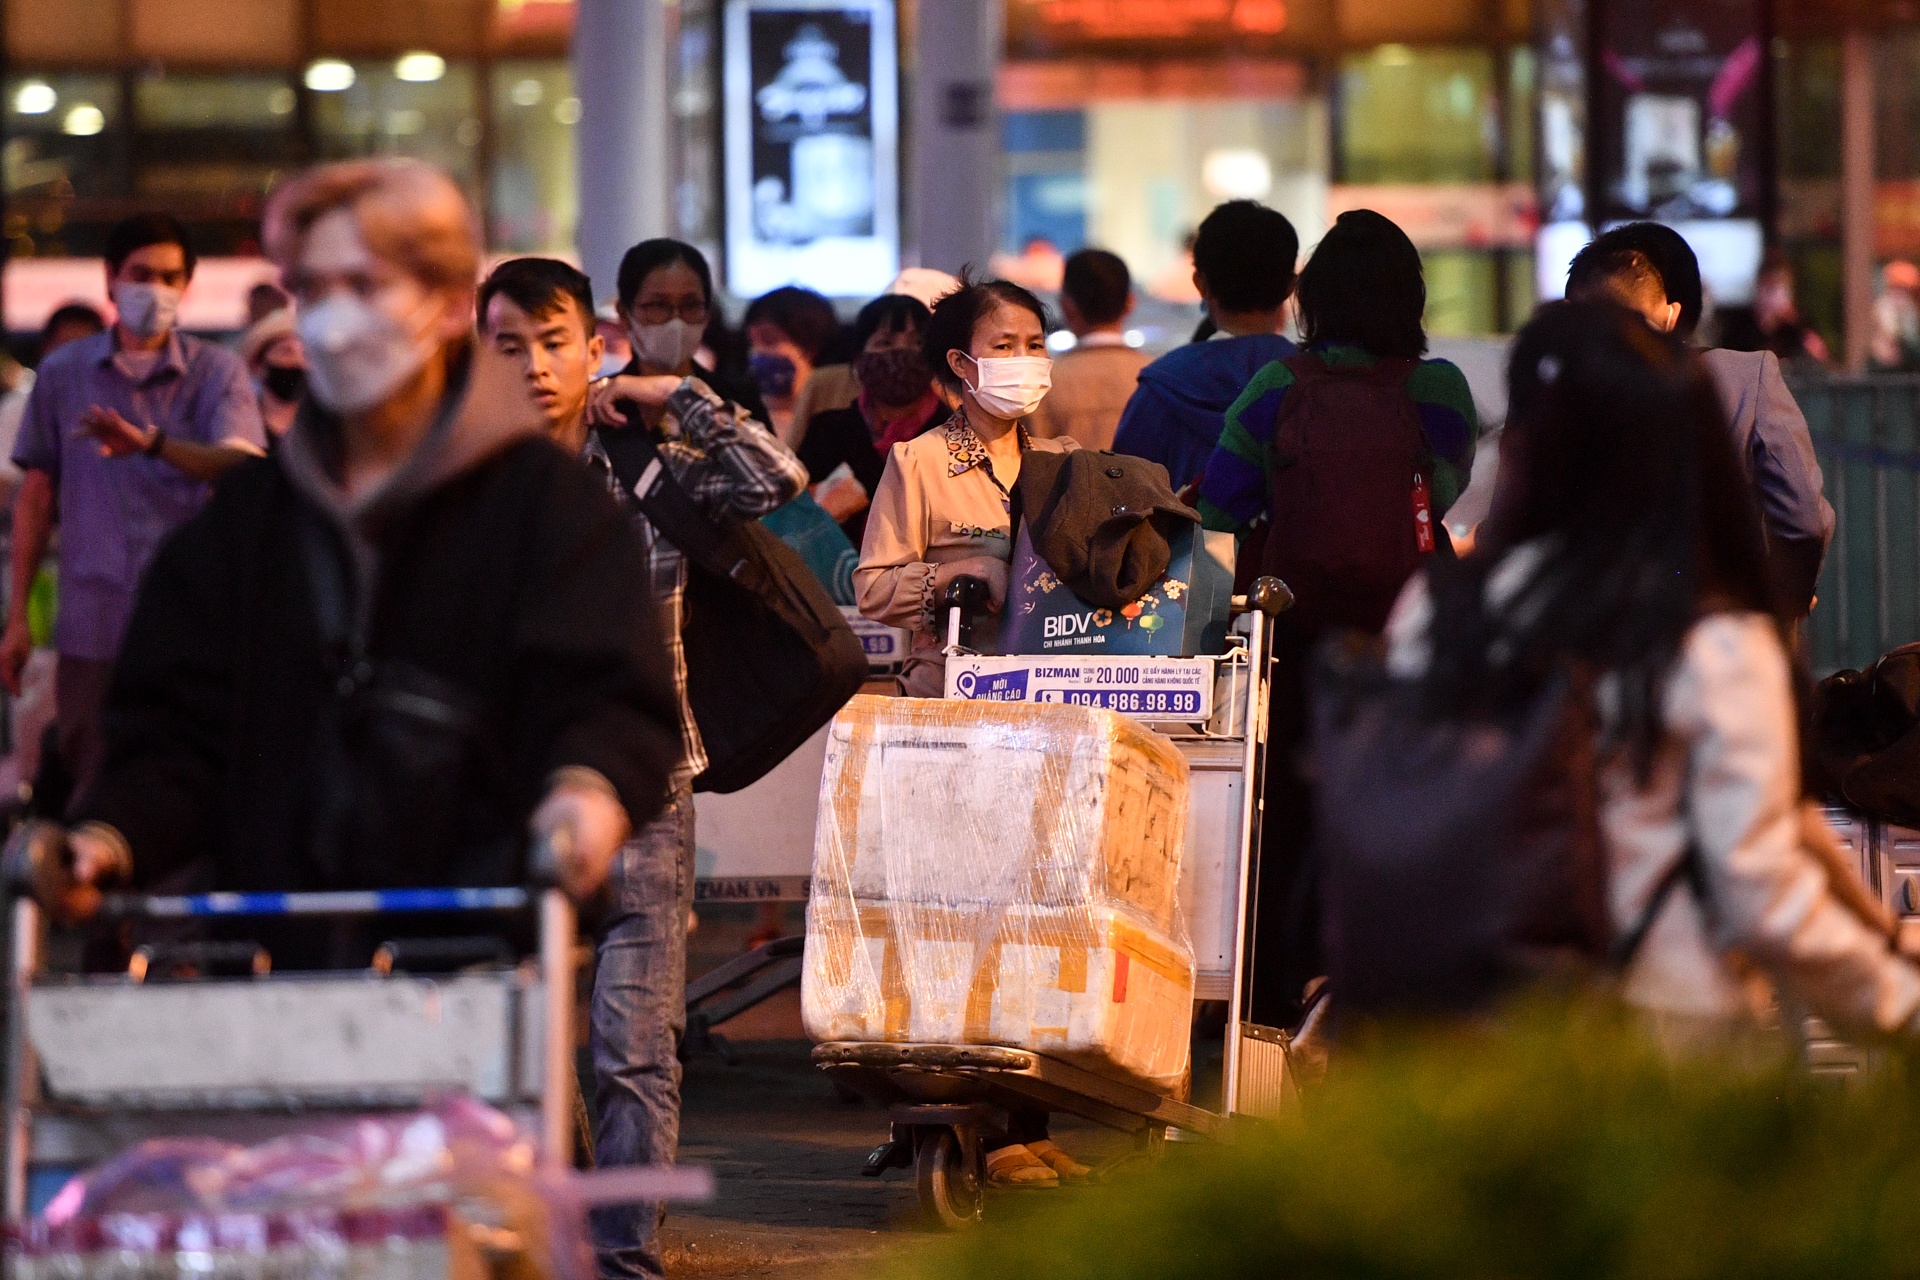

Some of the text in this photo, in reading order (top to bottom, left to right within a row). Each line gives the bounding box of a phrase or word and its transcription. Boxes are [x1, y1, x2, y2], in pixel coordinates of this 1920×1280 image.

[1043, 612, 1093, 638] BIDV
[1043, 633, 1105, 649] CHI NHÁNH THANH HÓA
[1035, 667, 1080, 678] BIZMAN
[1096, 666, 1139, 684] 20.000
[1161, 667, 1175, 675] HÀNH
[1175, 667, 1182, 675] LÝ
[1191, 667, 1201, 675] CÁC
[993, 678, 1008, 690] MỜI
[1004, 687, 1021, 700] CÁO
[1071, 692, 1194, 711] 094.986.98.98
